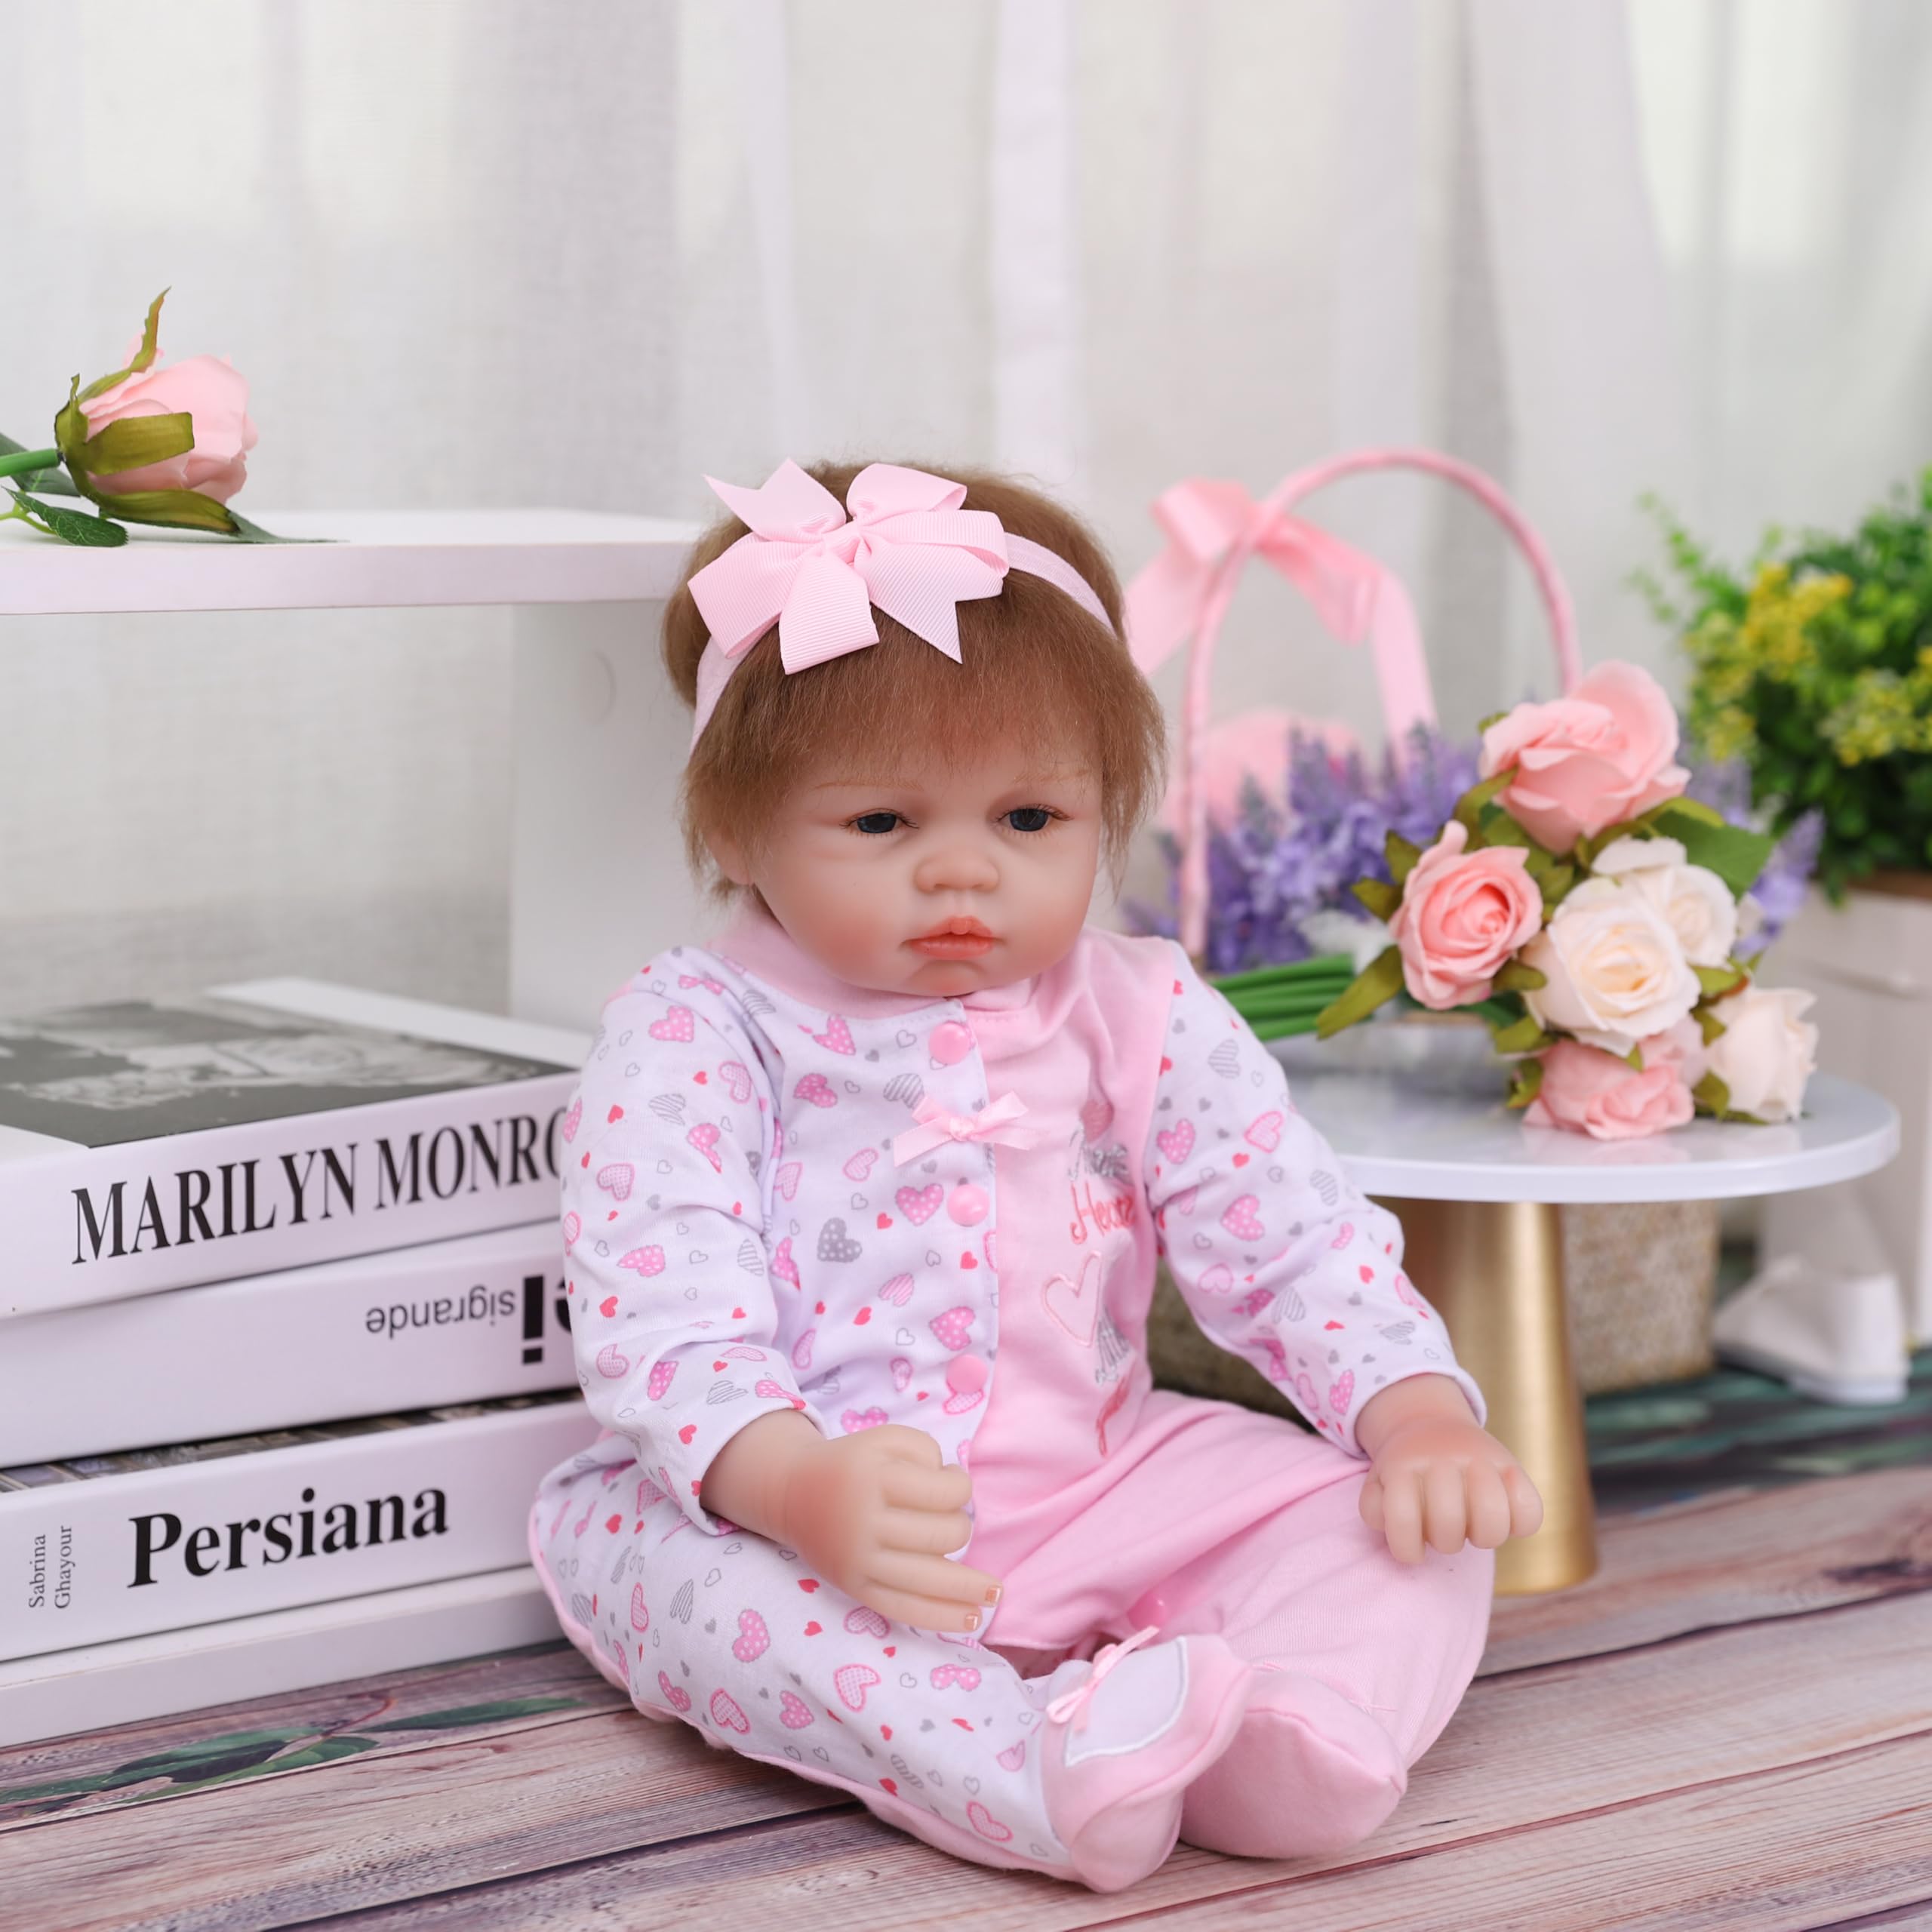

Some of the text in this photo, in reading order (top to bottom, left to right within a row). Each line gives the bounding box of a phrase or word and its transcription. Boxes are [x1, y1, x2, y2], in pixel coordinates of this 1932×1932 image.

[72, 1143, 358, 1264] MARILYN
[365, 1284, 516, 1340] sigrande
[28, 1534, 46, 1608] Sabrina
[54, 1525, 75, 1609] Ghayour
[127, 1487, 449, 1589] Persiana
